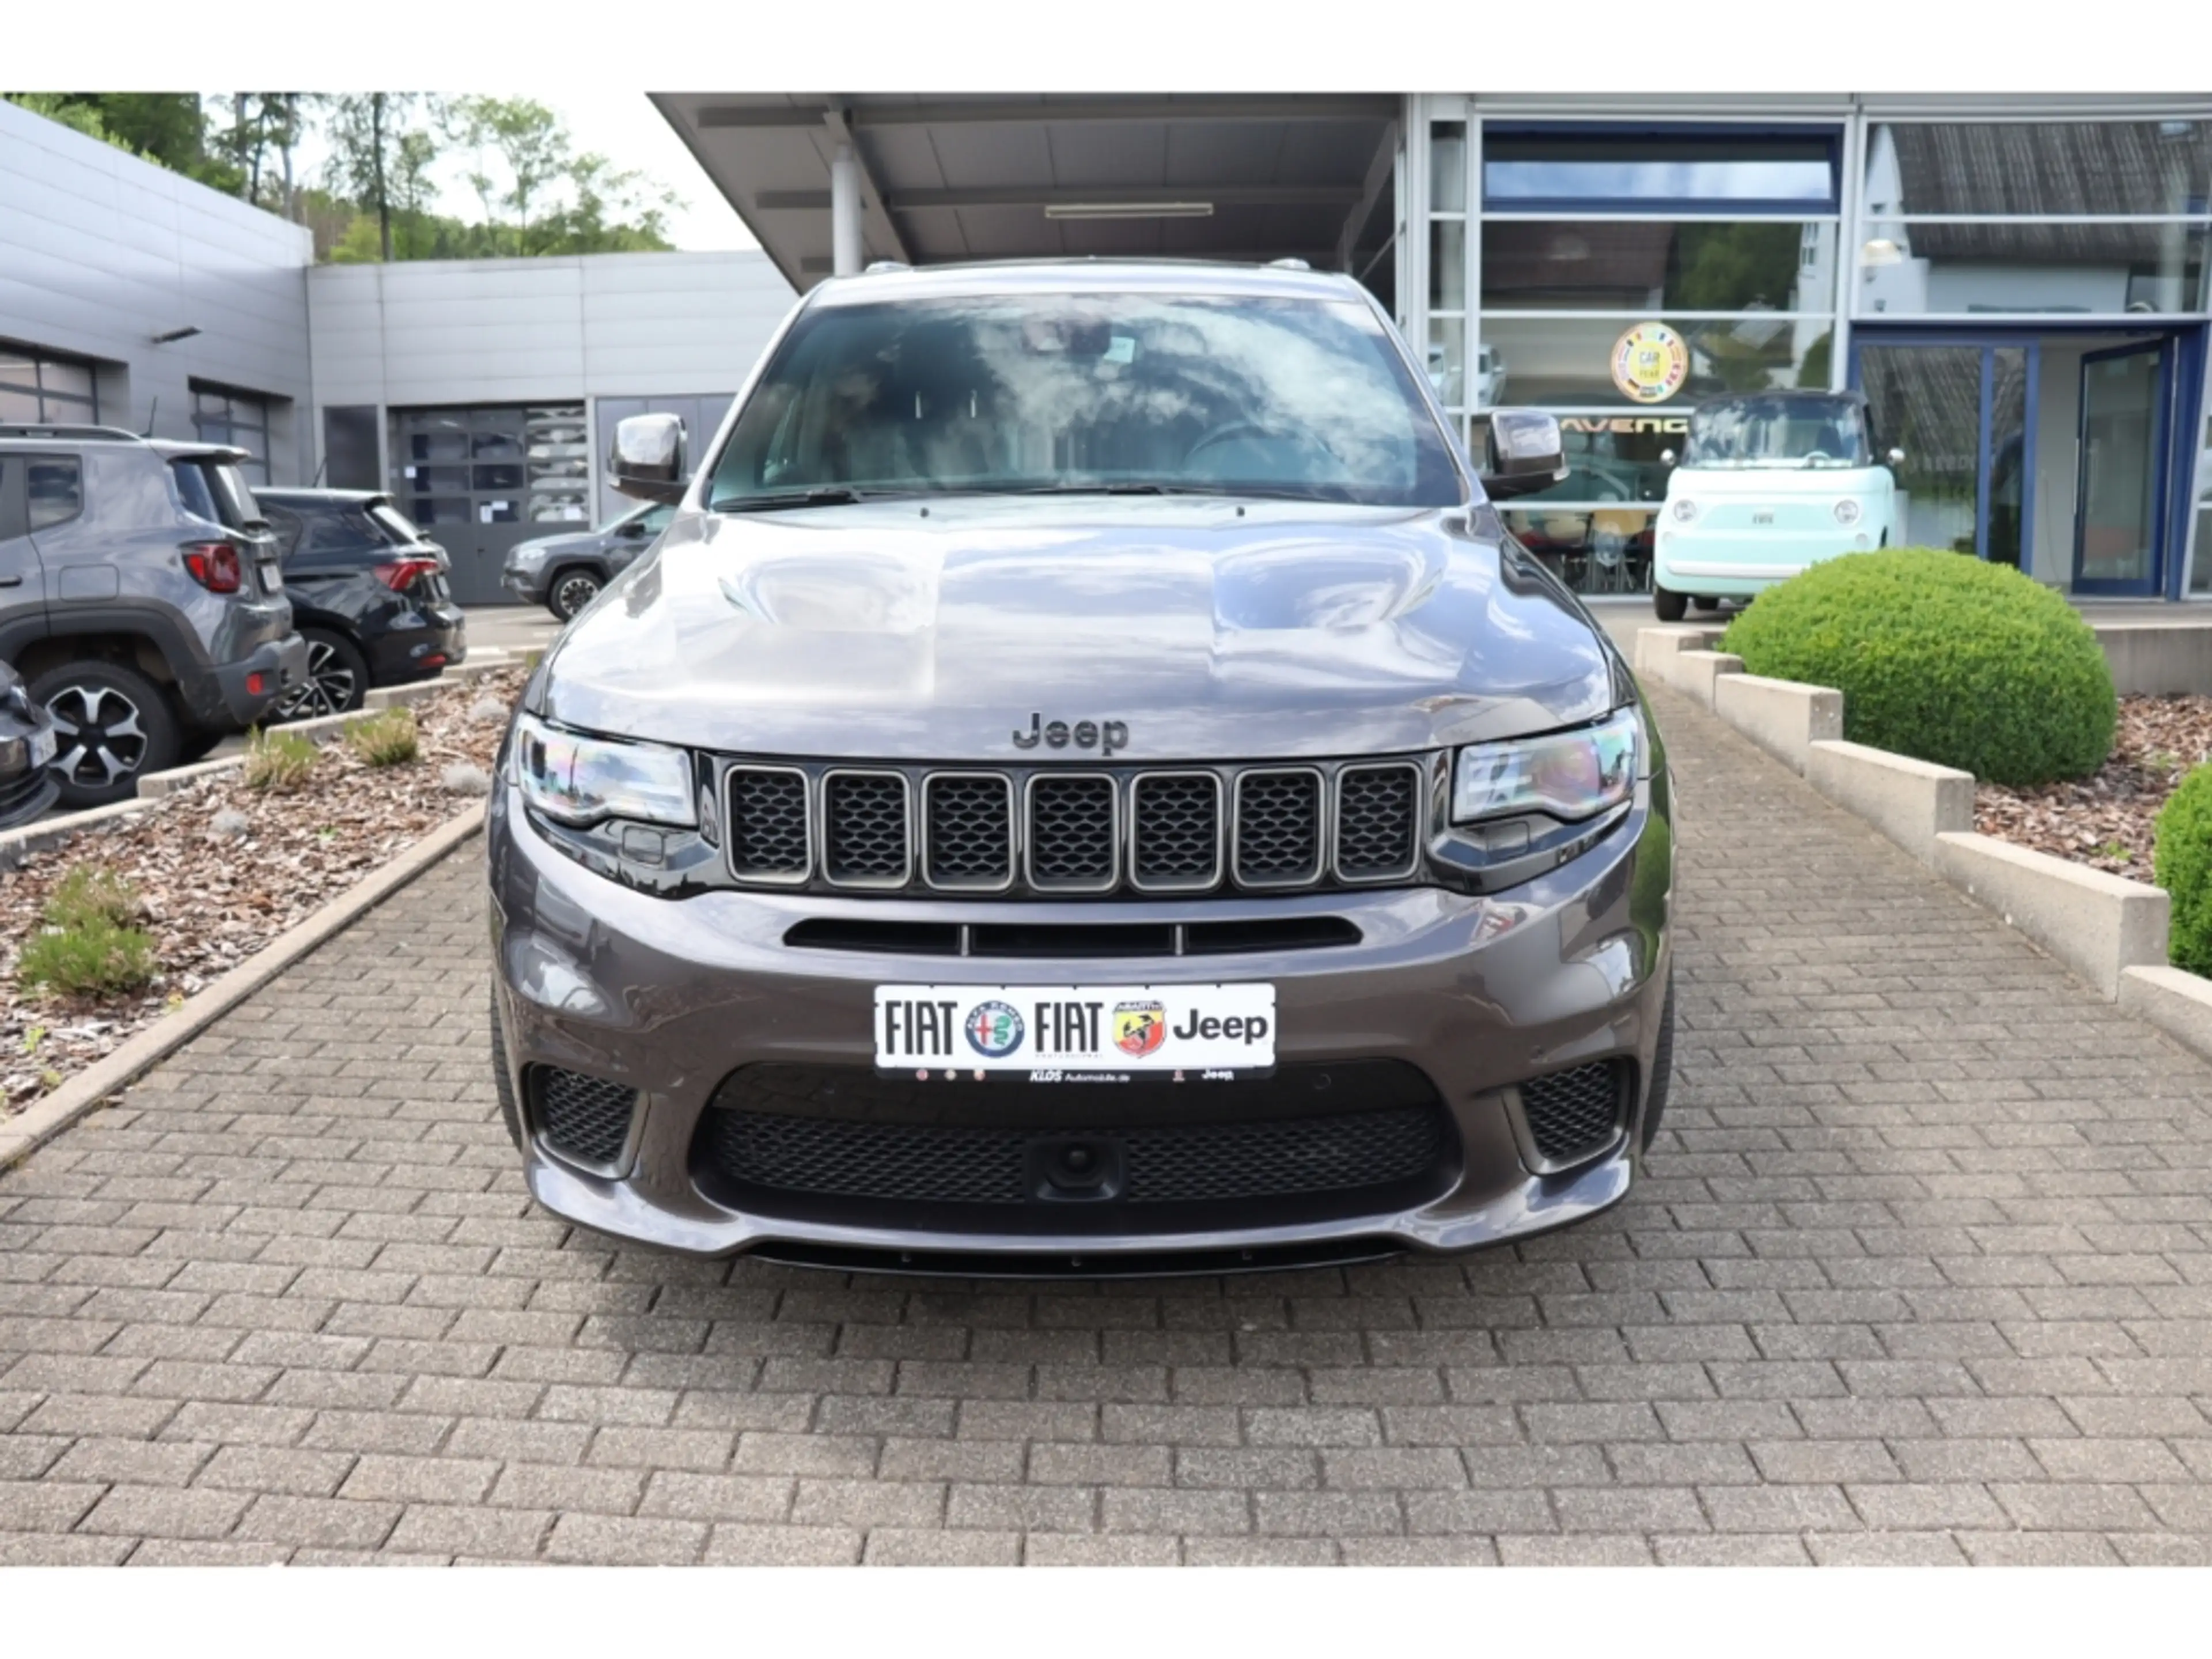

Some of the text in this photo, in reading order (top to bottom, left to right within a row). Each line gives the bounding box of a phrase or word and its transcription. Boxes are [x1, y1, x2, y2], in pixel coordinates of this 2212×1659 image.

[1639, 351, 1660, 363] CAR
[1012, 713, 1128, 756] Jeep
[885, 1000, 958, 1055] FIAT
[1035, 1002, 1104, 1052] FIAT
[1173, 1008, 1268, 1046] Jeep
[1029, 1070, 1062, 1082] KLOS
[1202, 1069, 1234, 1081] Jeep
